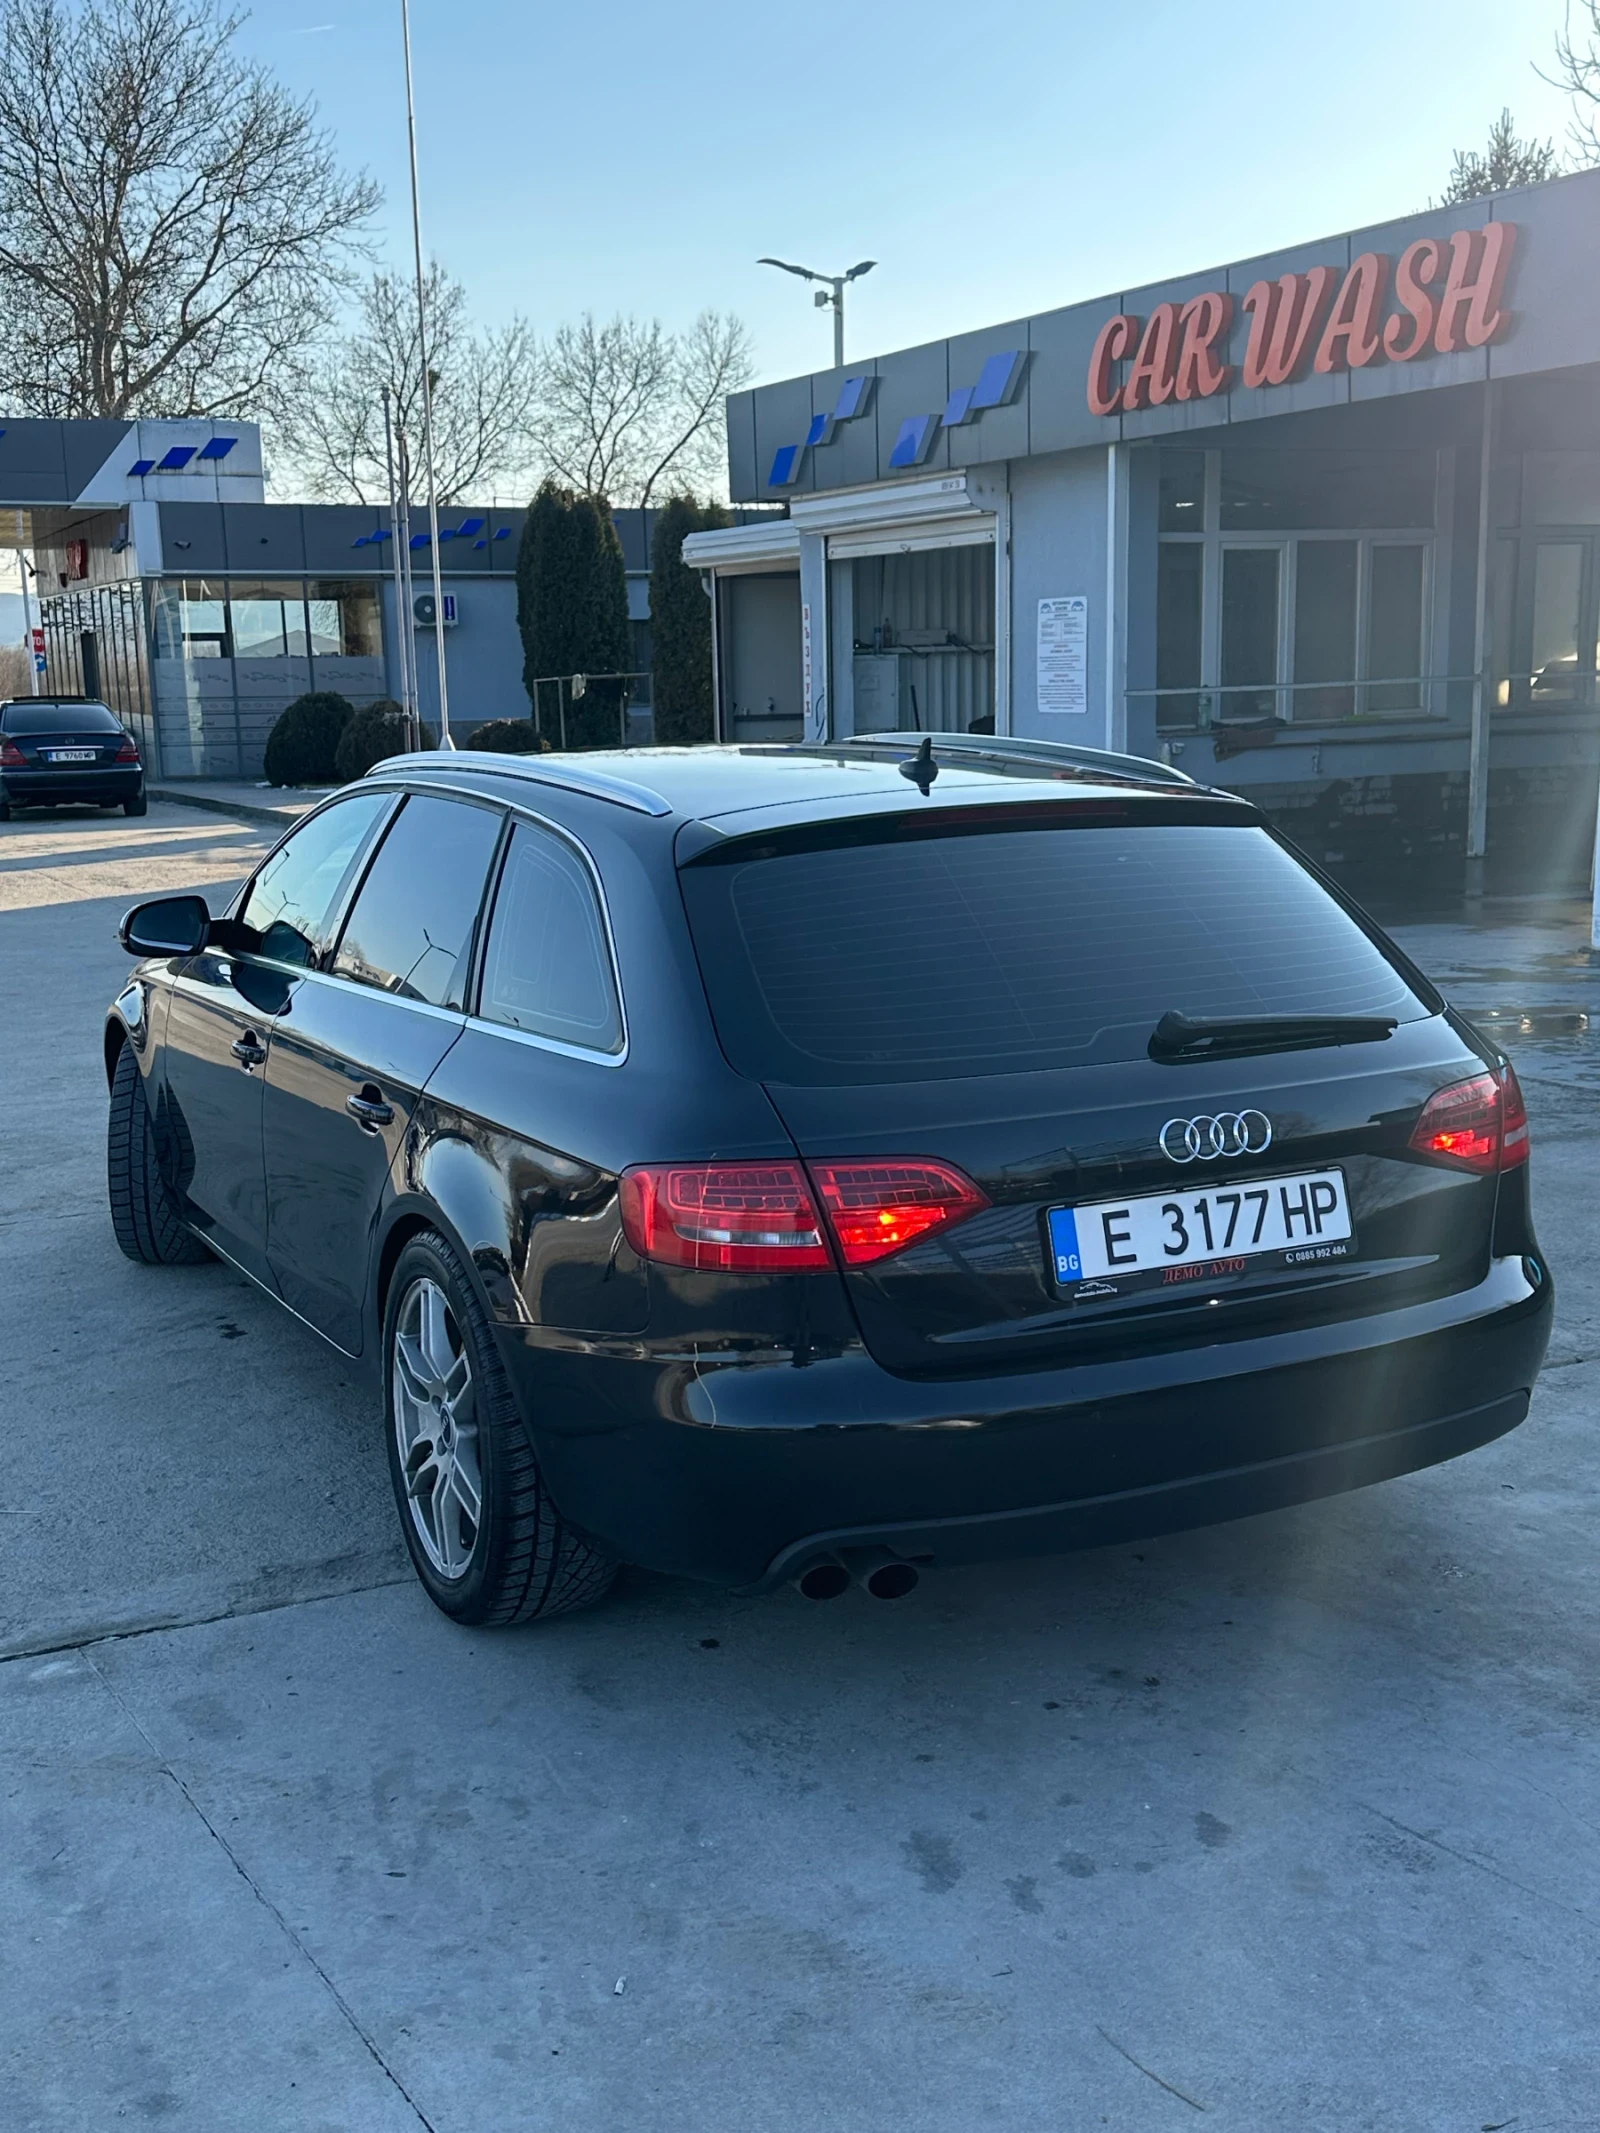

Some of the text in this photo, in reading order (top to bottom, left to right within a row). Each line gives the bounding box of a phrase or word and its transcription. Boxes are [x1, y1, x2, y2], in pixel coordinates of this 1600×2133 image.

[1087, 221, 1516, 416] CAR WASH
[1101, 1180, 1338, 1266] E 3177 HP
[1057, 1254, 1079, 1275] BG
[1162, 1264, 1203, 1285] ДЕМО
